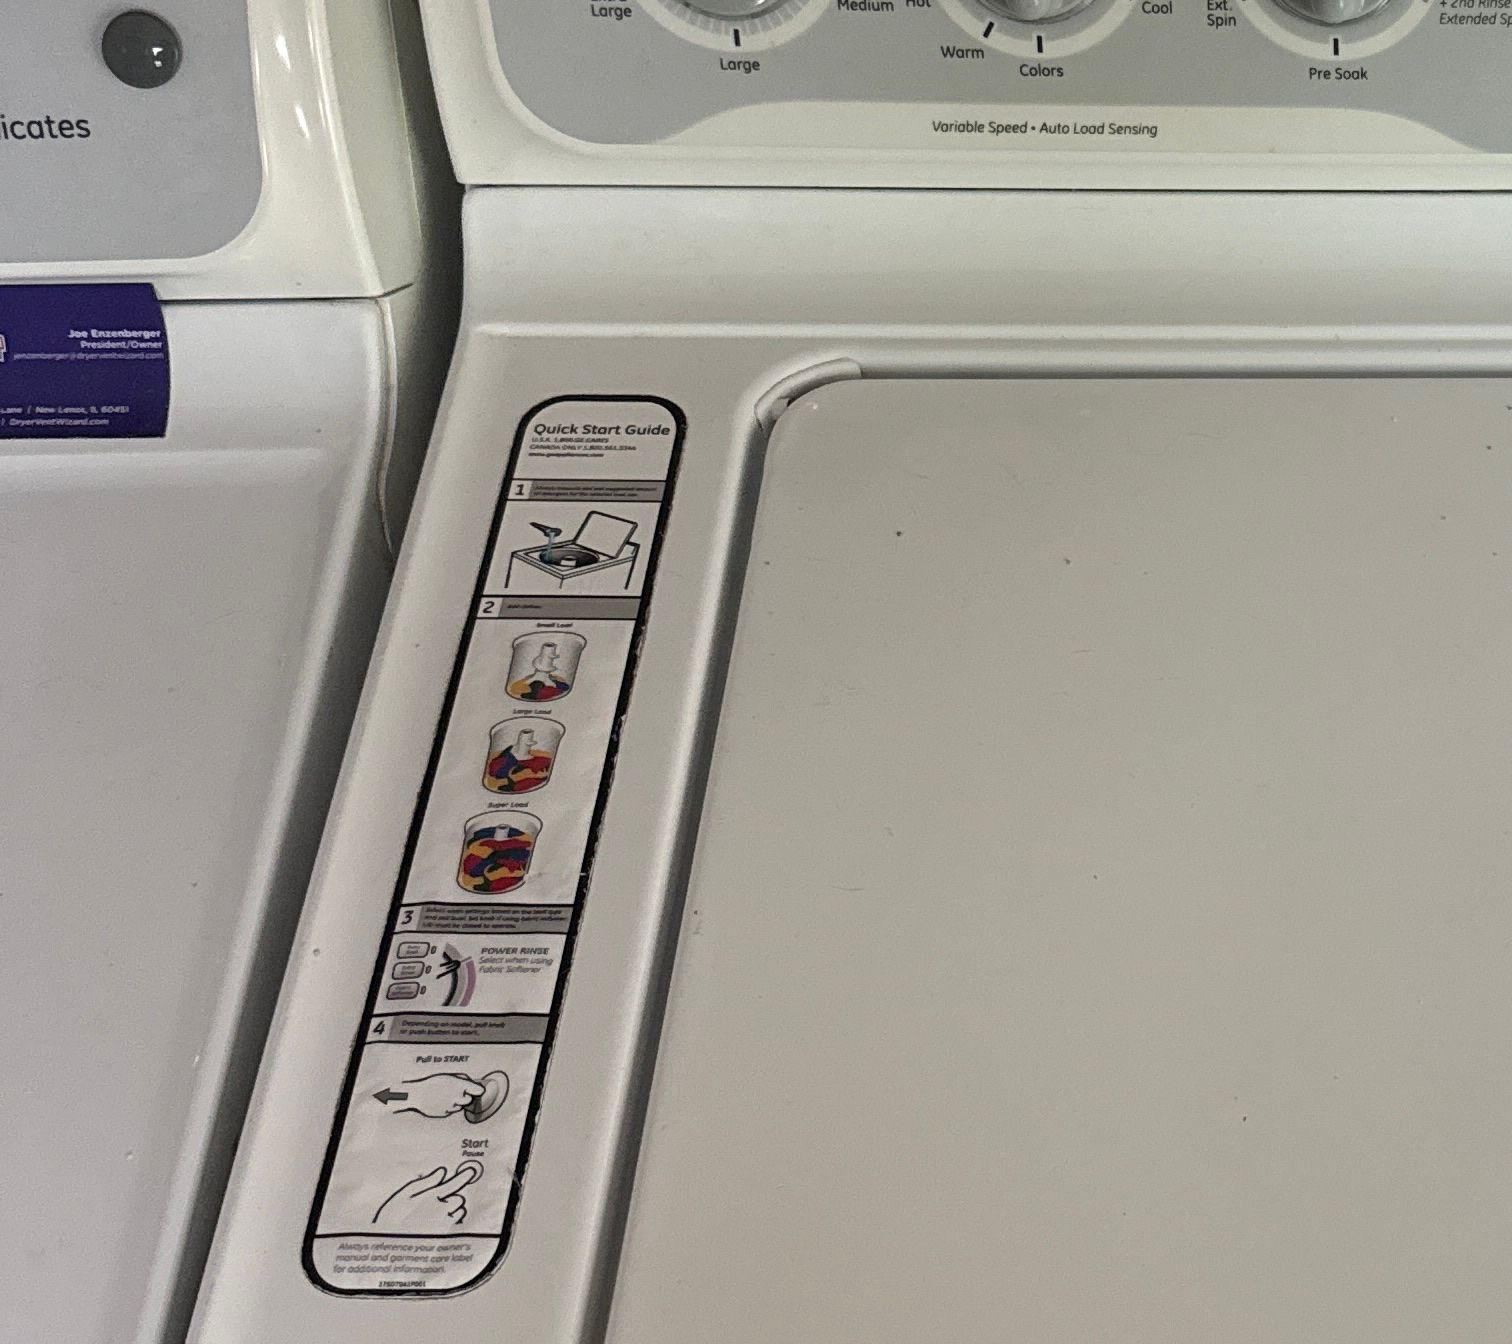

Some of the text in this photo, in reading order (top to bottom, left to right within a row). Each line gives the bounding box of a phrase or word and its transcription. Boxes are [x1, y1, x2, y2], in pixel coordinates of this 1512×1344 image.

[591, 4, 632, 20] Large
[1142, 1, 1172, 14] Cool
[1207, 14, 1236, 29] Spin
[1440, 12, 1497, 25] Extended
[941, 46, 984, 58] Warm
[720, 58, 760, 74] Large
[1020, 63, 1063, 77] Colors
[1309, 67, 1368, 80] Pre Soak
[2, 116, 90, 139] icates
[933, 120, 1157, 138] Variable Speed Auto Load Sensing
[533, 423, 671, 436] Quick Start Guide
[514, 484, 526, 497] 1
[482, 601, 495, 614] 2
[401, 910, 415, 925] 3
[481, 947, 550, 955] POWER RINSE
[373, 1020, 385, 1035] 4
[461, 1138, 489, 1149] Start
[338, 1243, 369, 1251] Always
[371, 1254, 389, 1262] and
